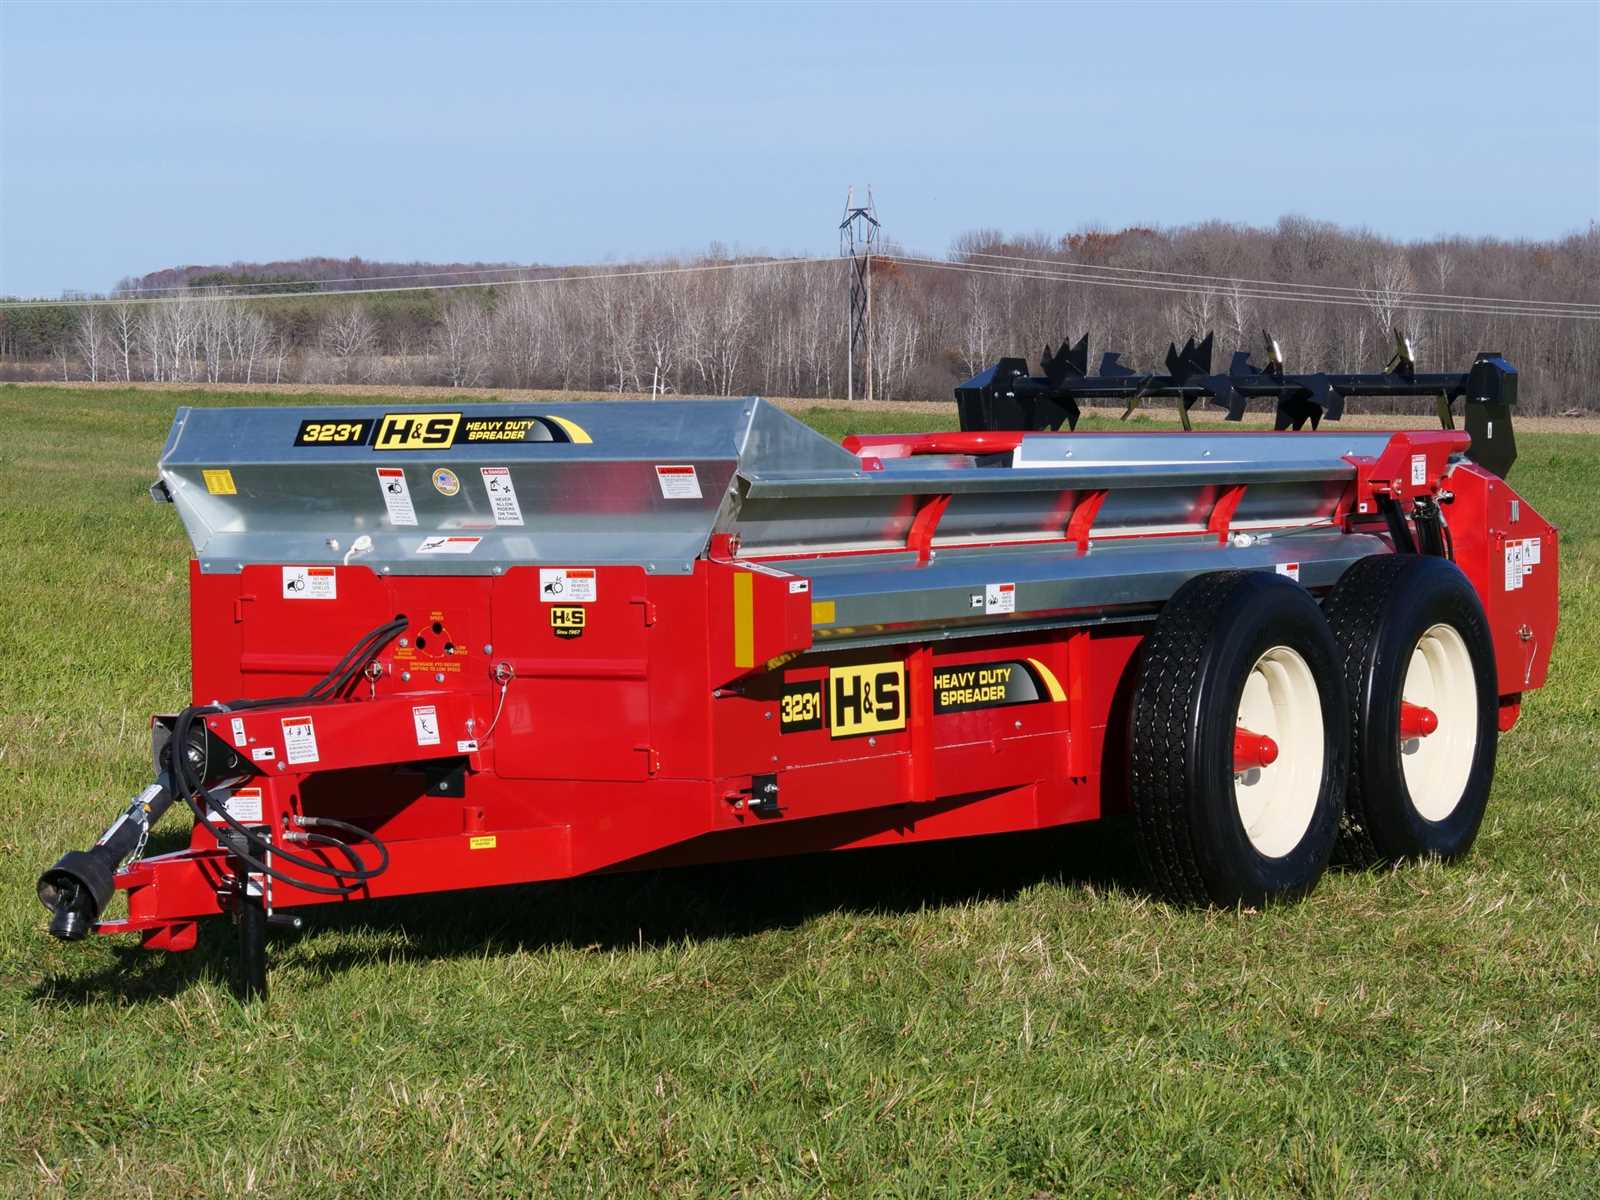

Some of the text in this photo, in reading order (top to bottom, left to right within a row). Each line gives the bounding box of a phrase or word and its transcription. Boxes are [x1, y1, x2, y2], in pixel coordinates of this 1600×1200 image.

[303, 424, 362, 442] 3231
[381, 418, 454, 445] H&S
[465, 420, 535, 432] HEAVY DUTY
[468, 430, 526, 441] SPREADER
[552, 610, 583, 624] H&S
[934, 668, 1011, 690] HEAVY DUTY
[835, 671, 900, 728] H&S
[940, 685, 1006, 707] SPREADER
[781, 692, 820, 723] 3231
